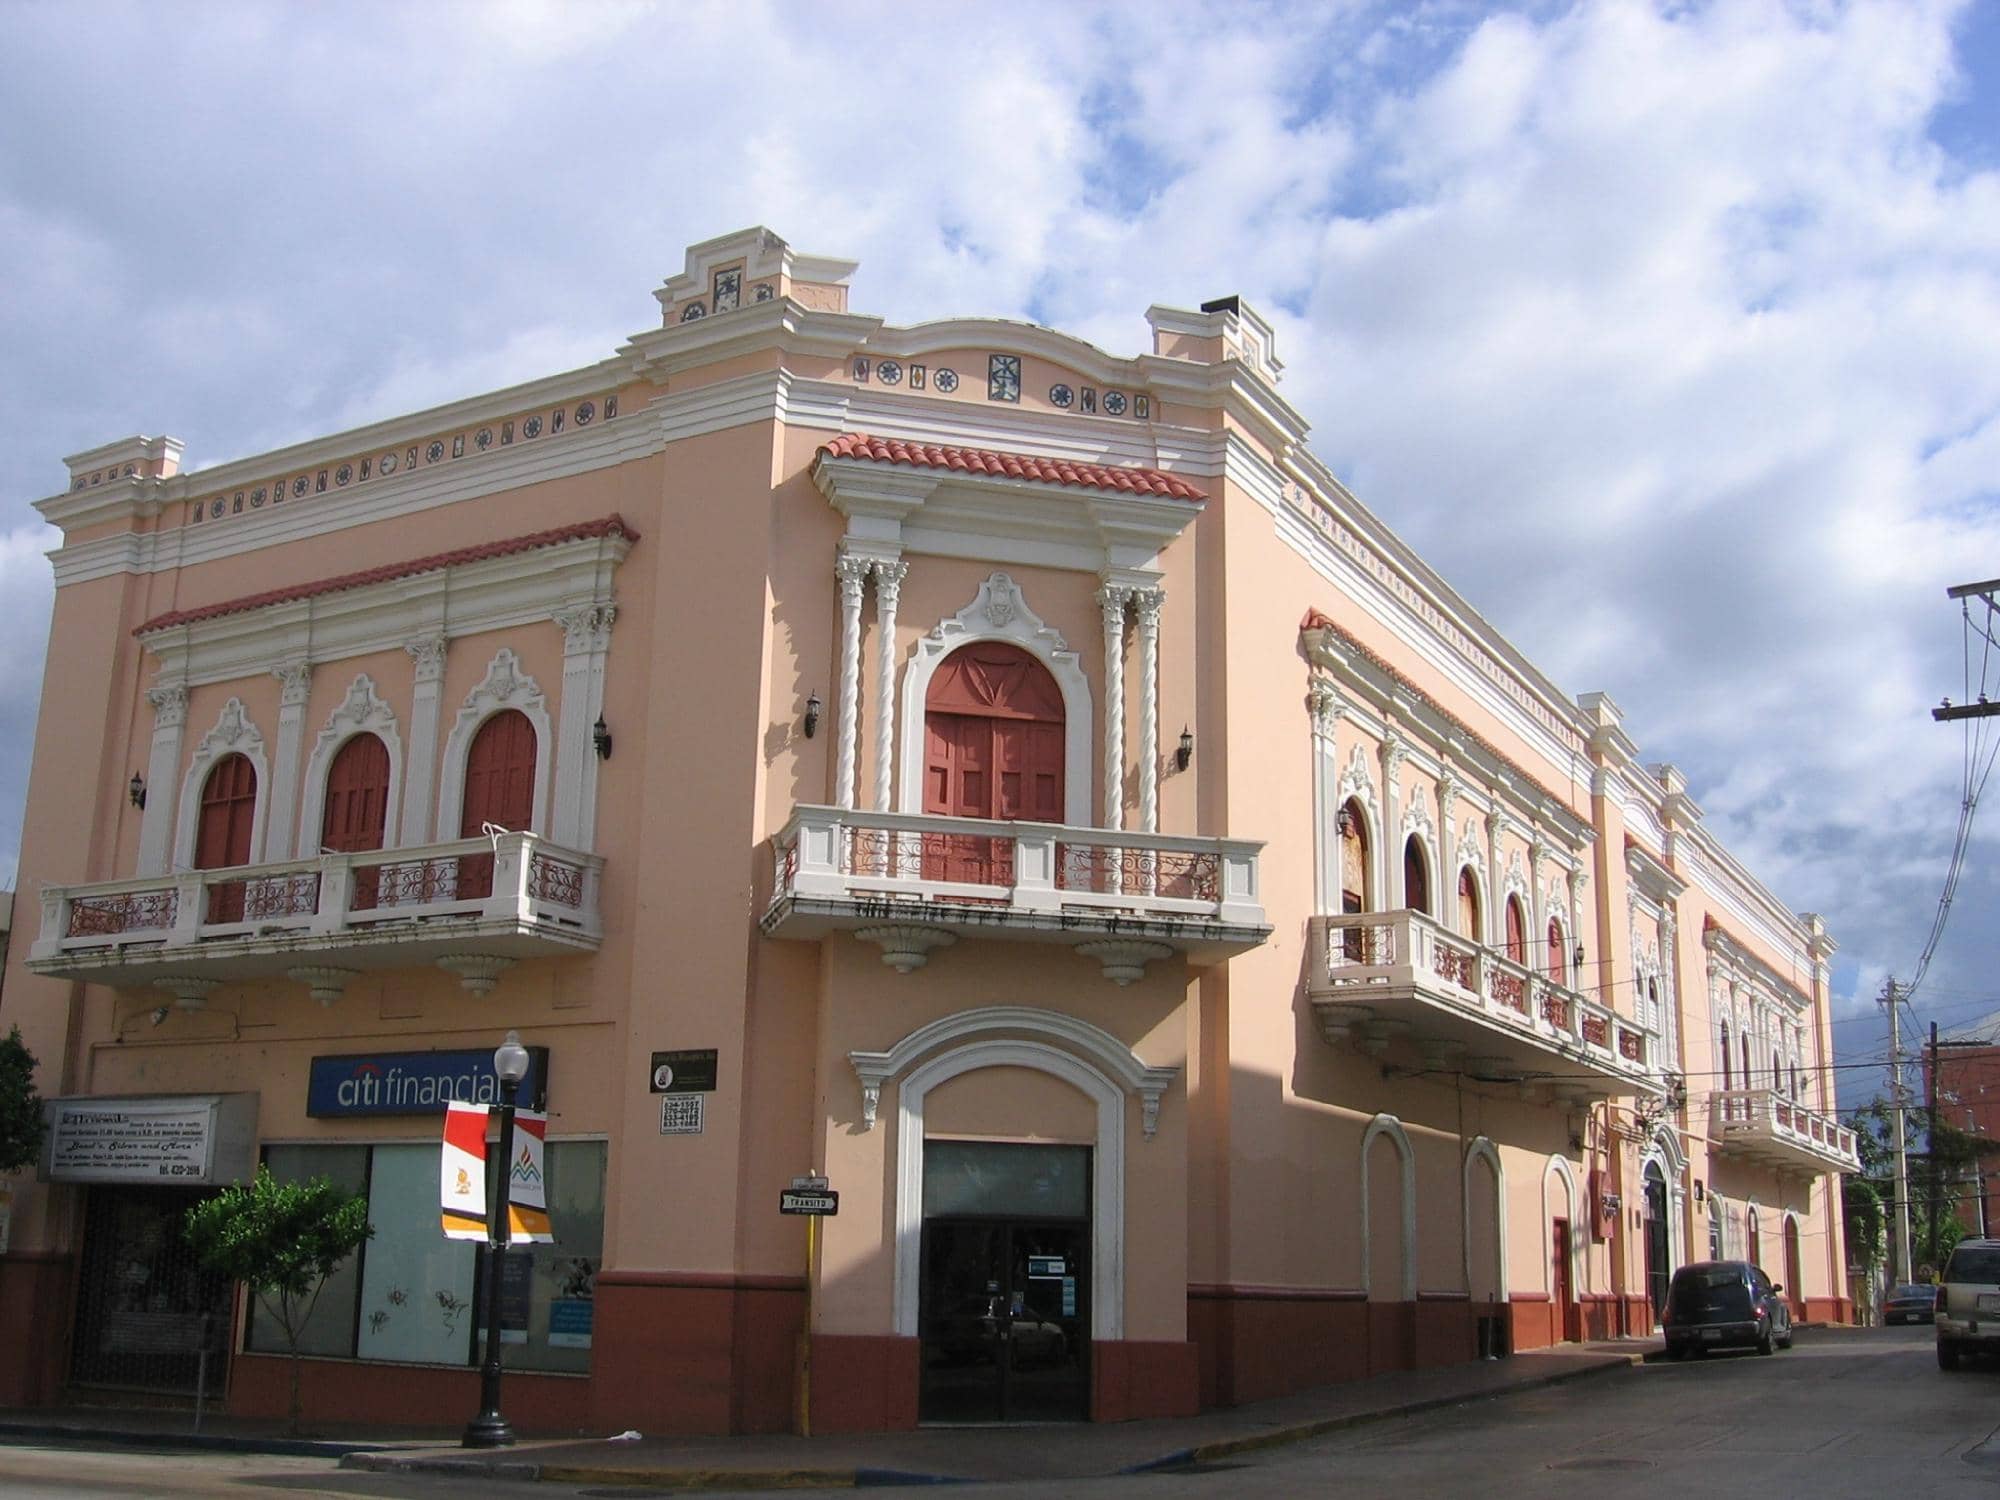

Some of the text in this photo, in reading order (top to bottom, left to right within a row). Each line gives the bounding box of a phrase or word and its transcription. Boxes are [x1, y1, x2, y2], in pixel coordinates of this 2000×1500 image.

[337, 1065, 502, 1107] citi financial
[790, 1199, 826, 1207] TRANSITO
